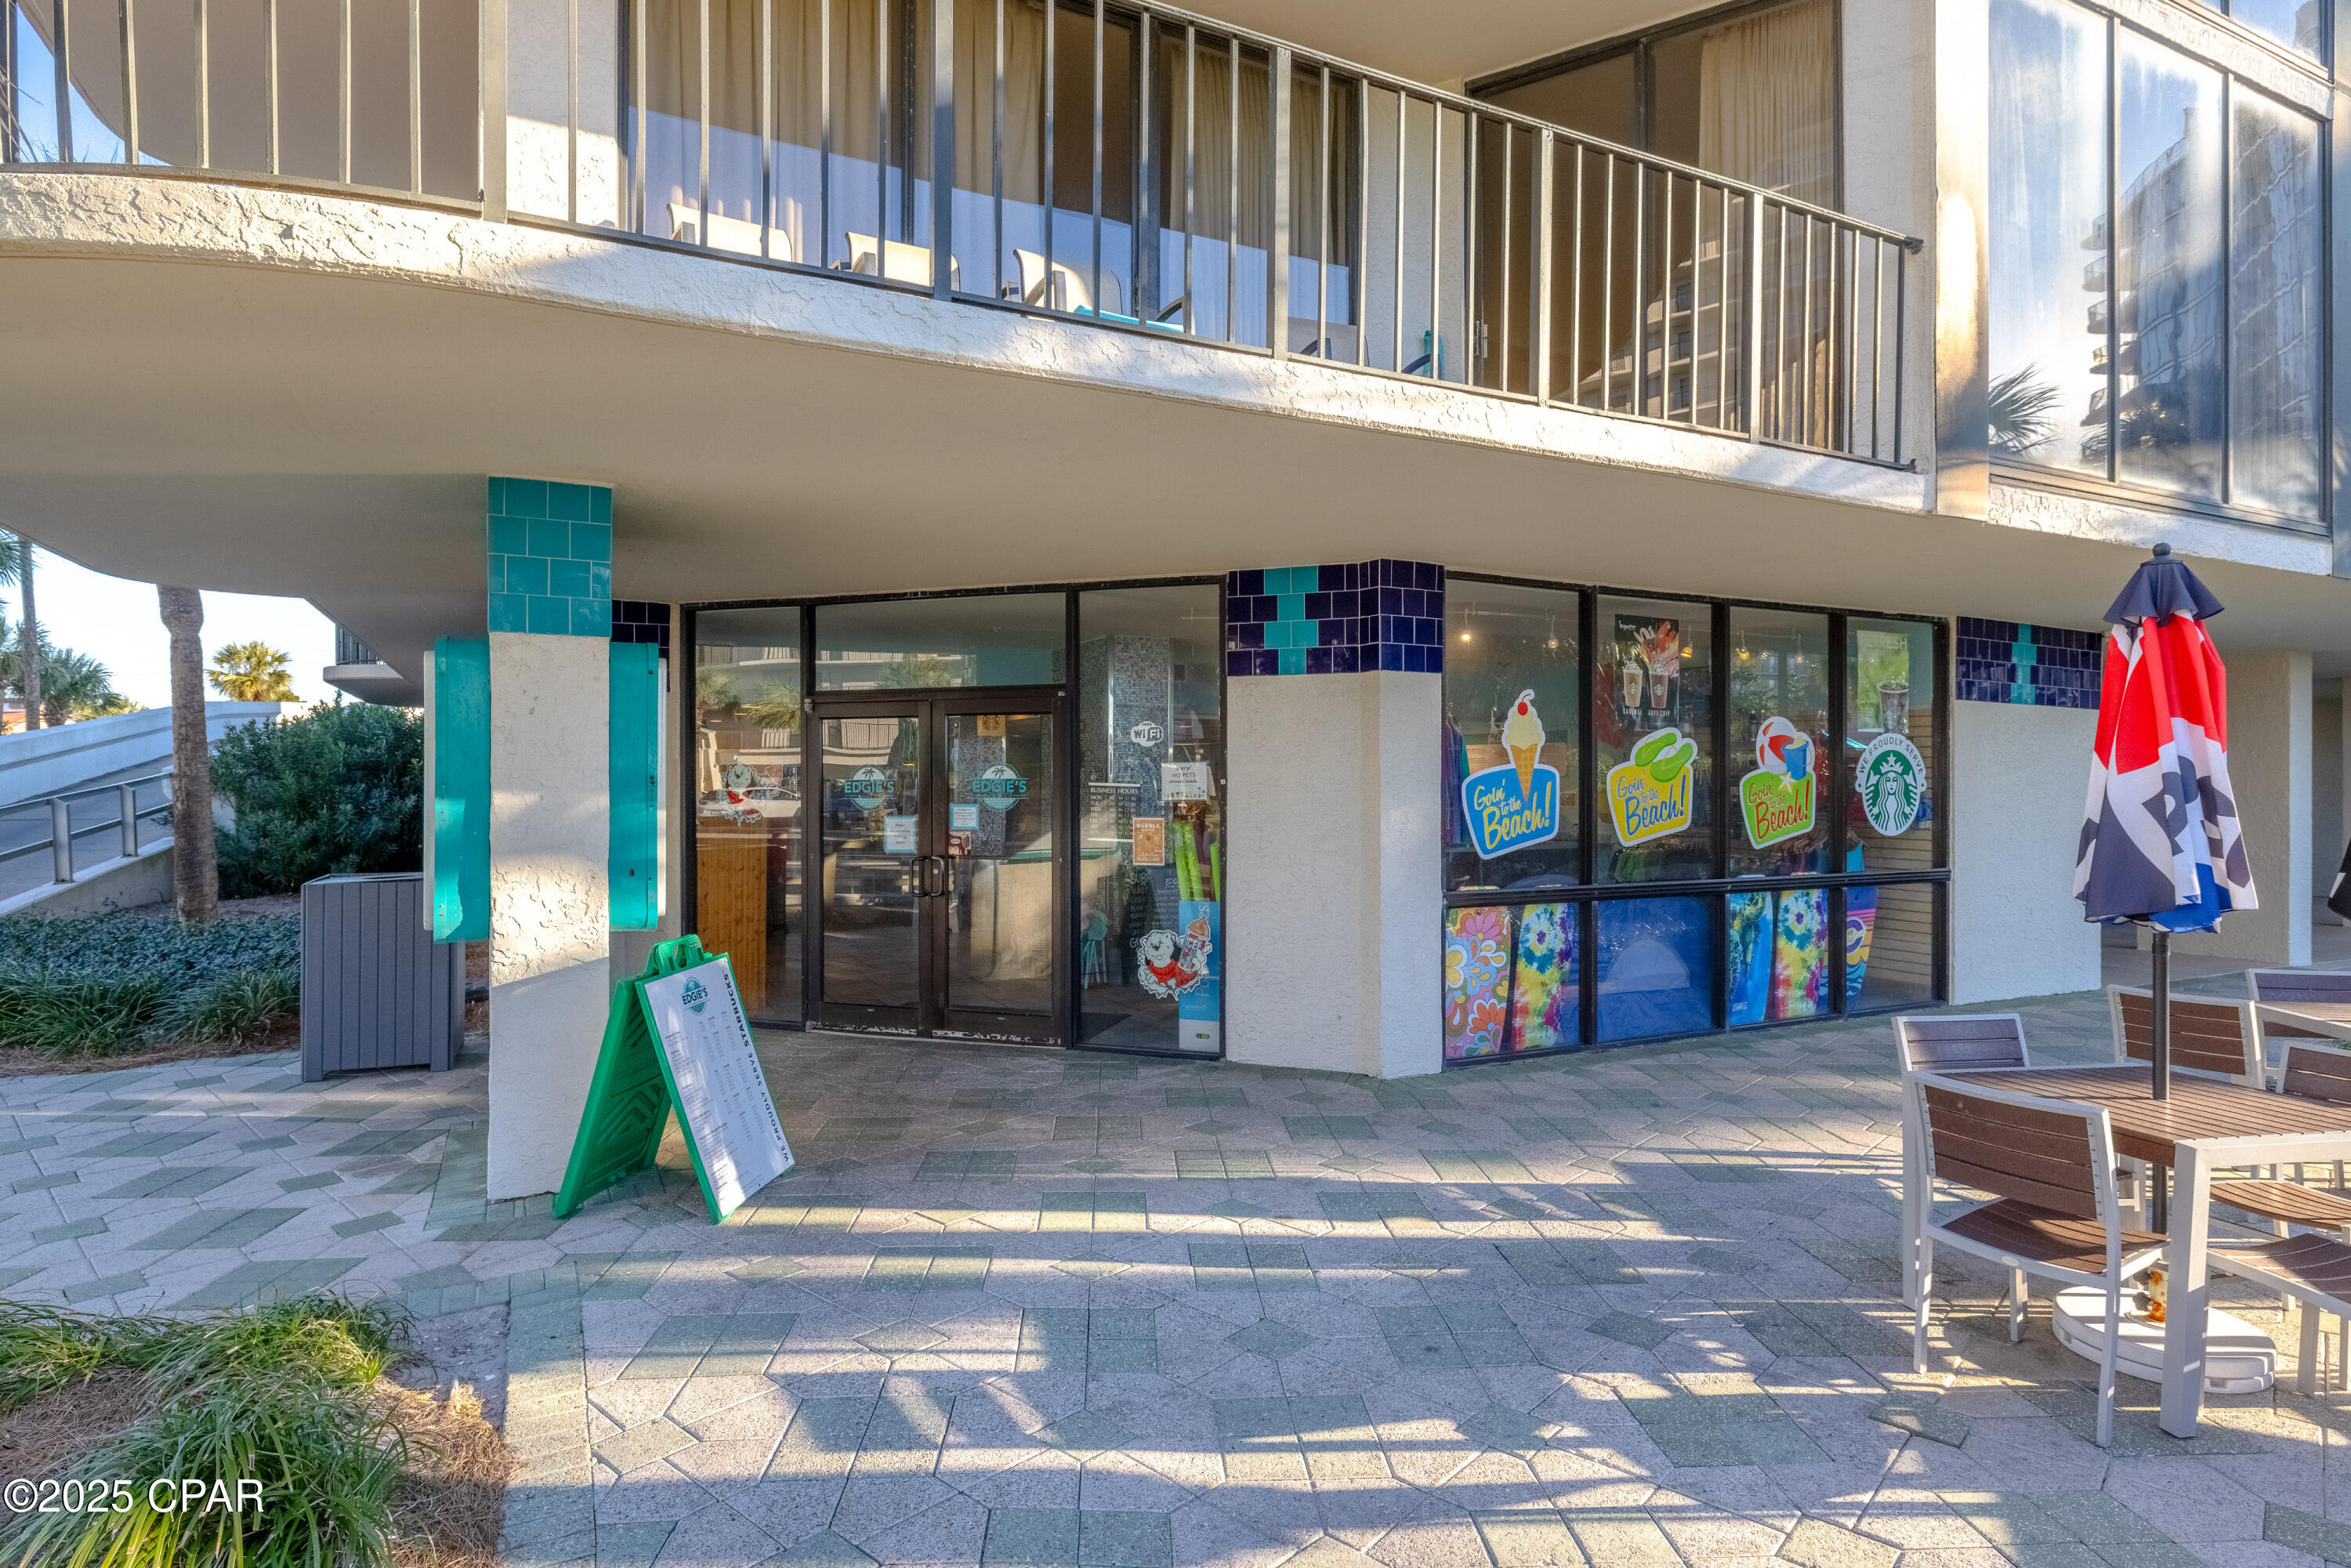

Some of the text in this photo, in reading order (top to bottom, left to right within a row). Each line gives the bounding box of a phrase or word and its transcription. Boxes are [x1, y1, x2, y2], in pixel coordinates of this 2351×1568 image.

[1861, 635, 1907, 650] REFRESH
[1859, 737, 1924, 775] WE PROUDLY SERVE
[844, 780, 895, 793] EDGIE'S
[973, 780, 1027, 793] EDGIE'S
[1474, 778, 1505, 810] Goin'
[1617, 770, 1644, 799] Goin'
[1639, 791, 1647, 804] to
[1748, 777, 1773, 805] Goin'
[1483, 781, 1552, 849] Beach!
[1499, 795, 1522, 816] to the
[1625, 773, 1686, 837] Beach!
[1755, 779, 1810, 841] Beach!
[682, 987, 708, 1005] EDGIE'S
[723, 973, 749, 1048] STARBUCKS
[748, 1052, 762, 1087] SERVE
[760, 1091, 781, 1141] PROUDLY
[780, 1145, 788, 1162] WE
